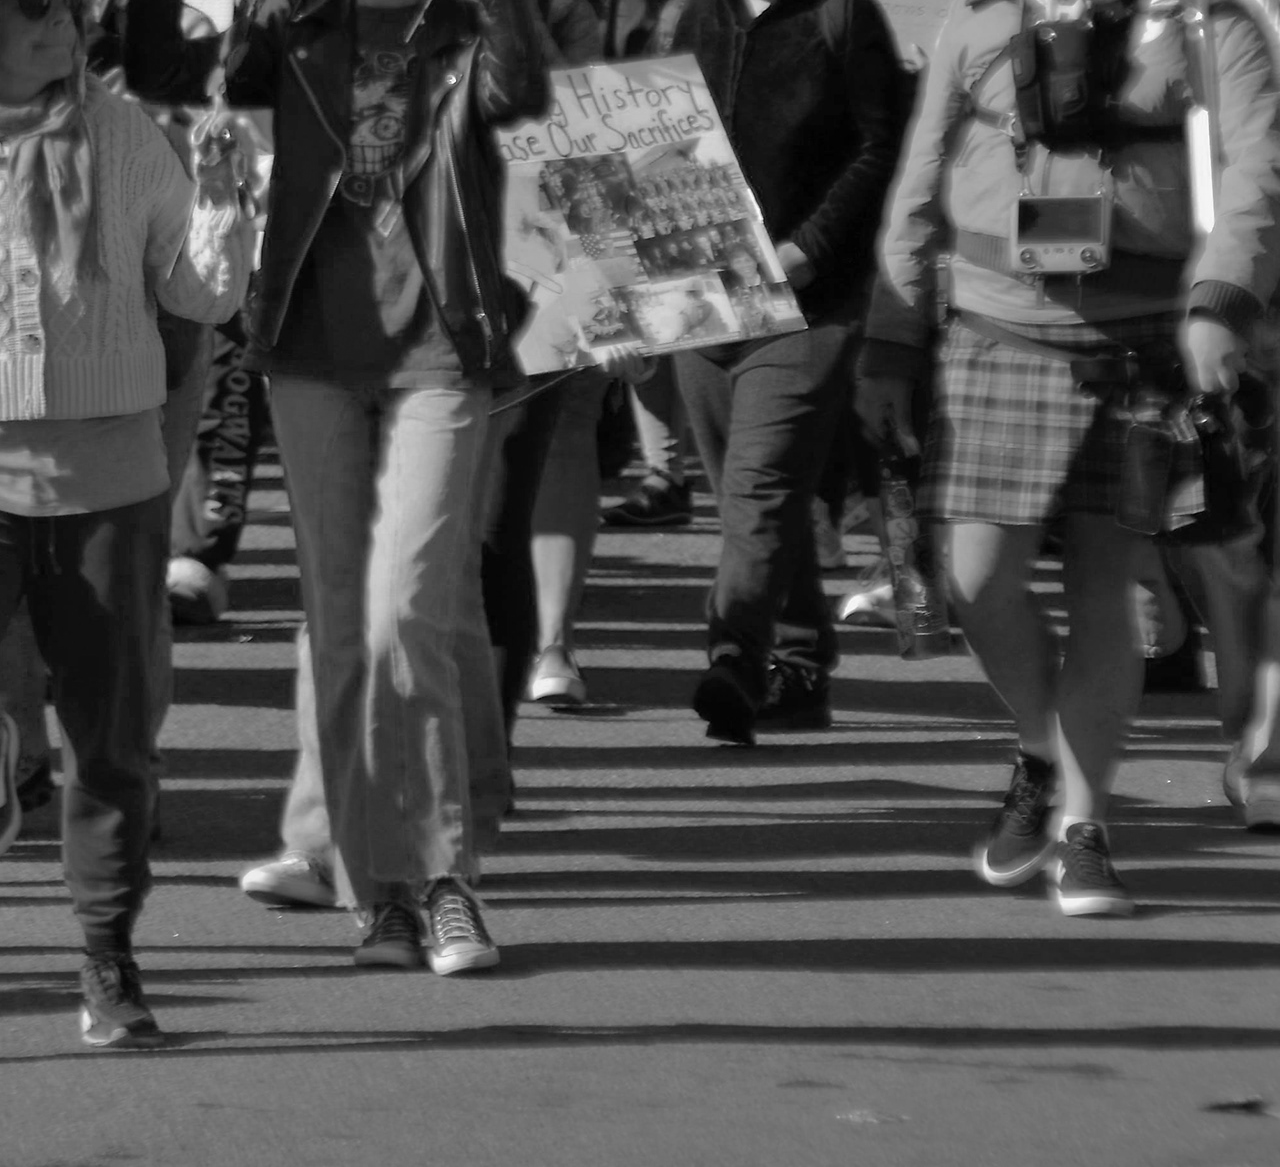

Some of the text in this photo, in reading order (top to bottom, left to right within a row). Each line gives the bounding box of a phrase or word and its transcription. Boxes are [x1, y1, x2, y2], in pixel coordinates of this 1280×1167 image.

[566, 70, 707, 121] History
[548, 120, 598, 158] Our
[599, 108, 717, 152] Sacrifices
